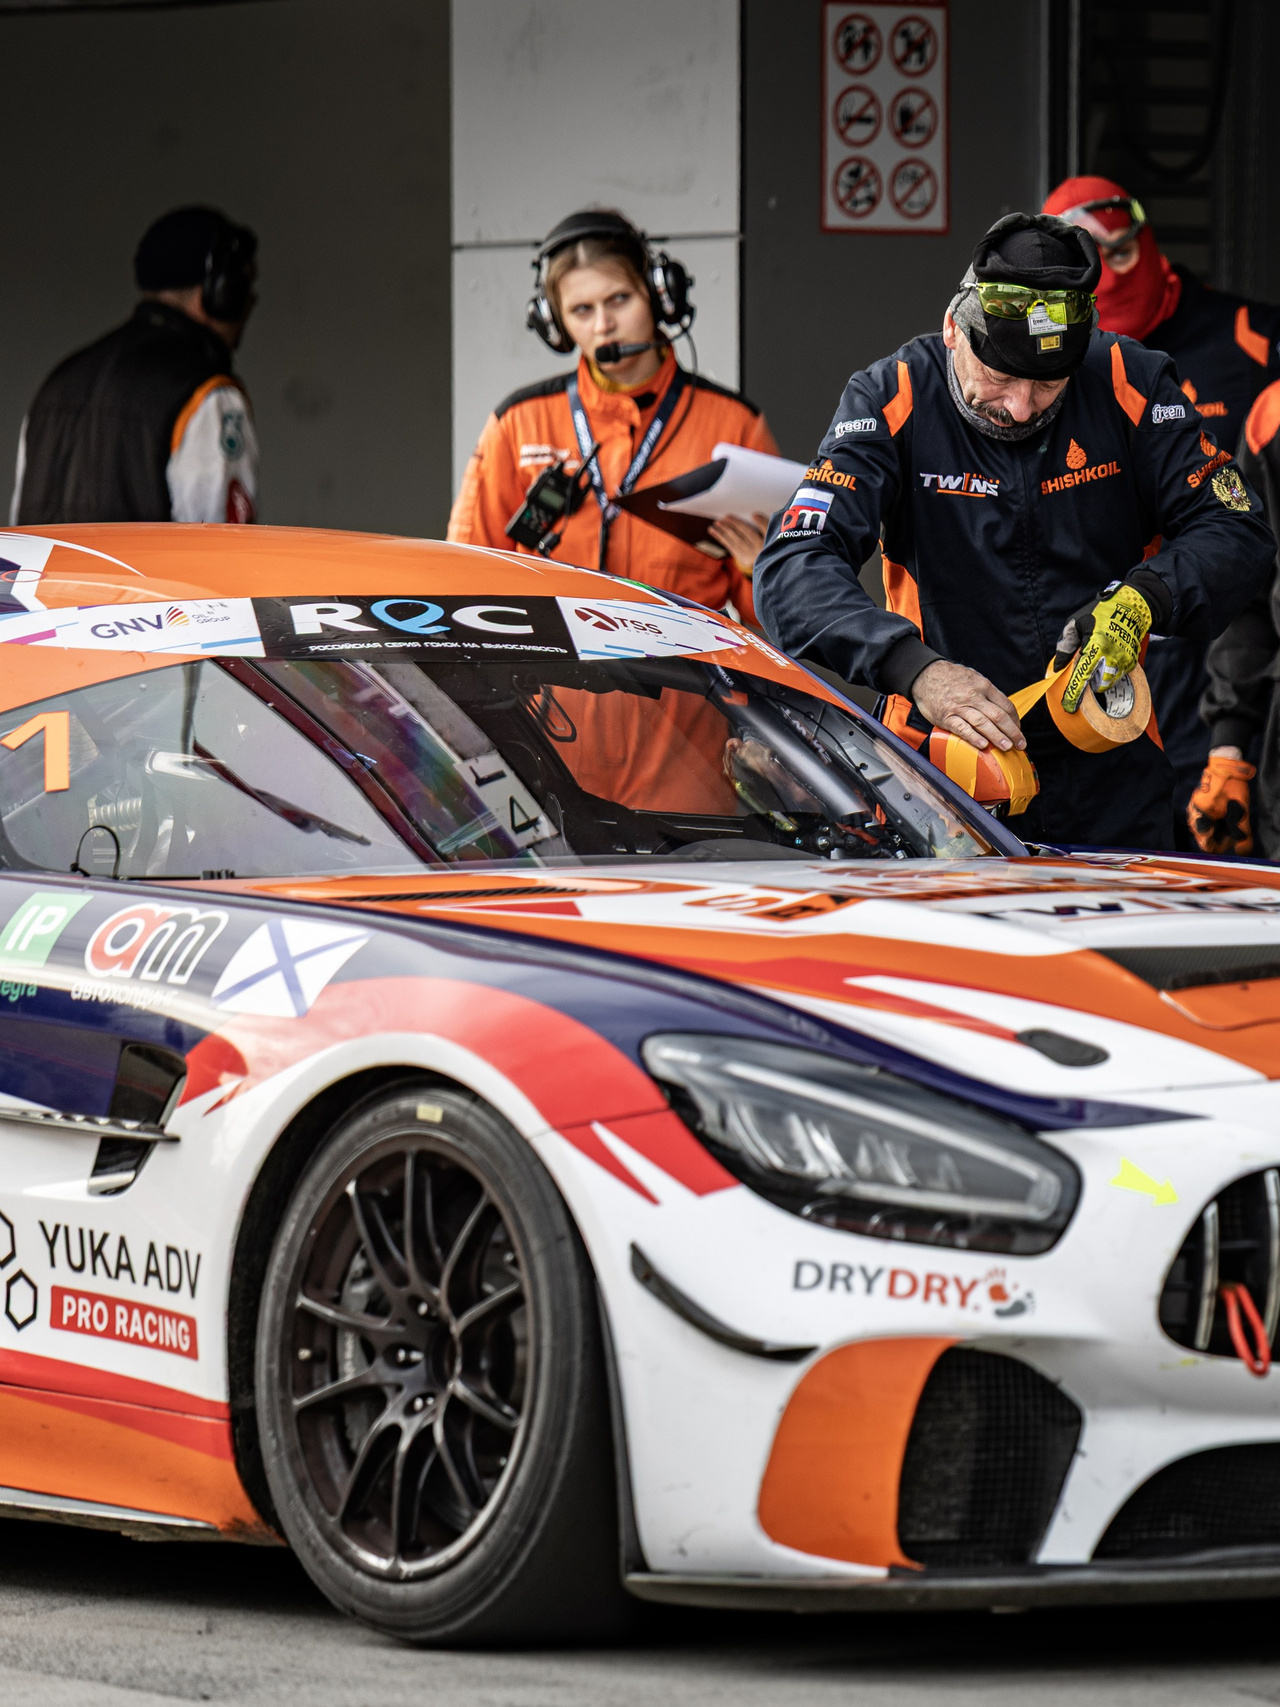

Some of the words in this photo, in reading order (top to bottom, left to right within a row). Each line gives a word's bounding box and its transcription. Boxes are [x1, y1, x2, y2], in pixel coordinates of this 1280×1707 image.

[1151, 403, 1186, 424] freem
[835, 418, 877, 439] freem
[919, 472, 999, 497] TWINS
[1041, 461, 1122, 495] SHISHKOIL
[91, 614, 164, 639] GNV
[614, 617, 663, 635] TSS
[38, 1219, 136, 1284] YUKA
[143, 1240, 202, 1299] ADV
[62, 1294, 109, 1332] PRO
[114, 1304, 191, 1352] RACING
